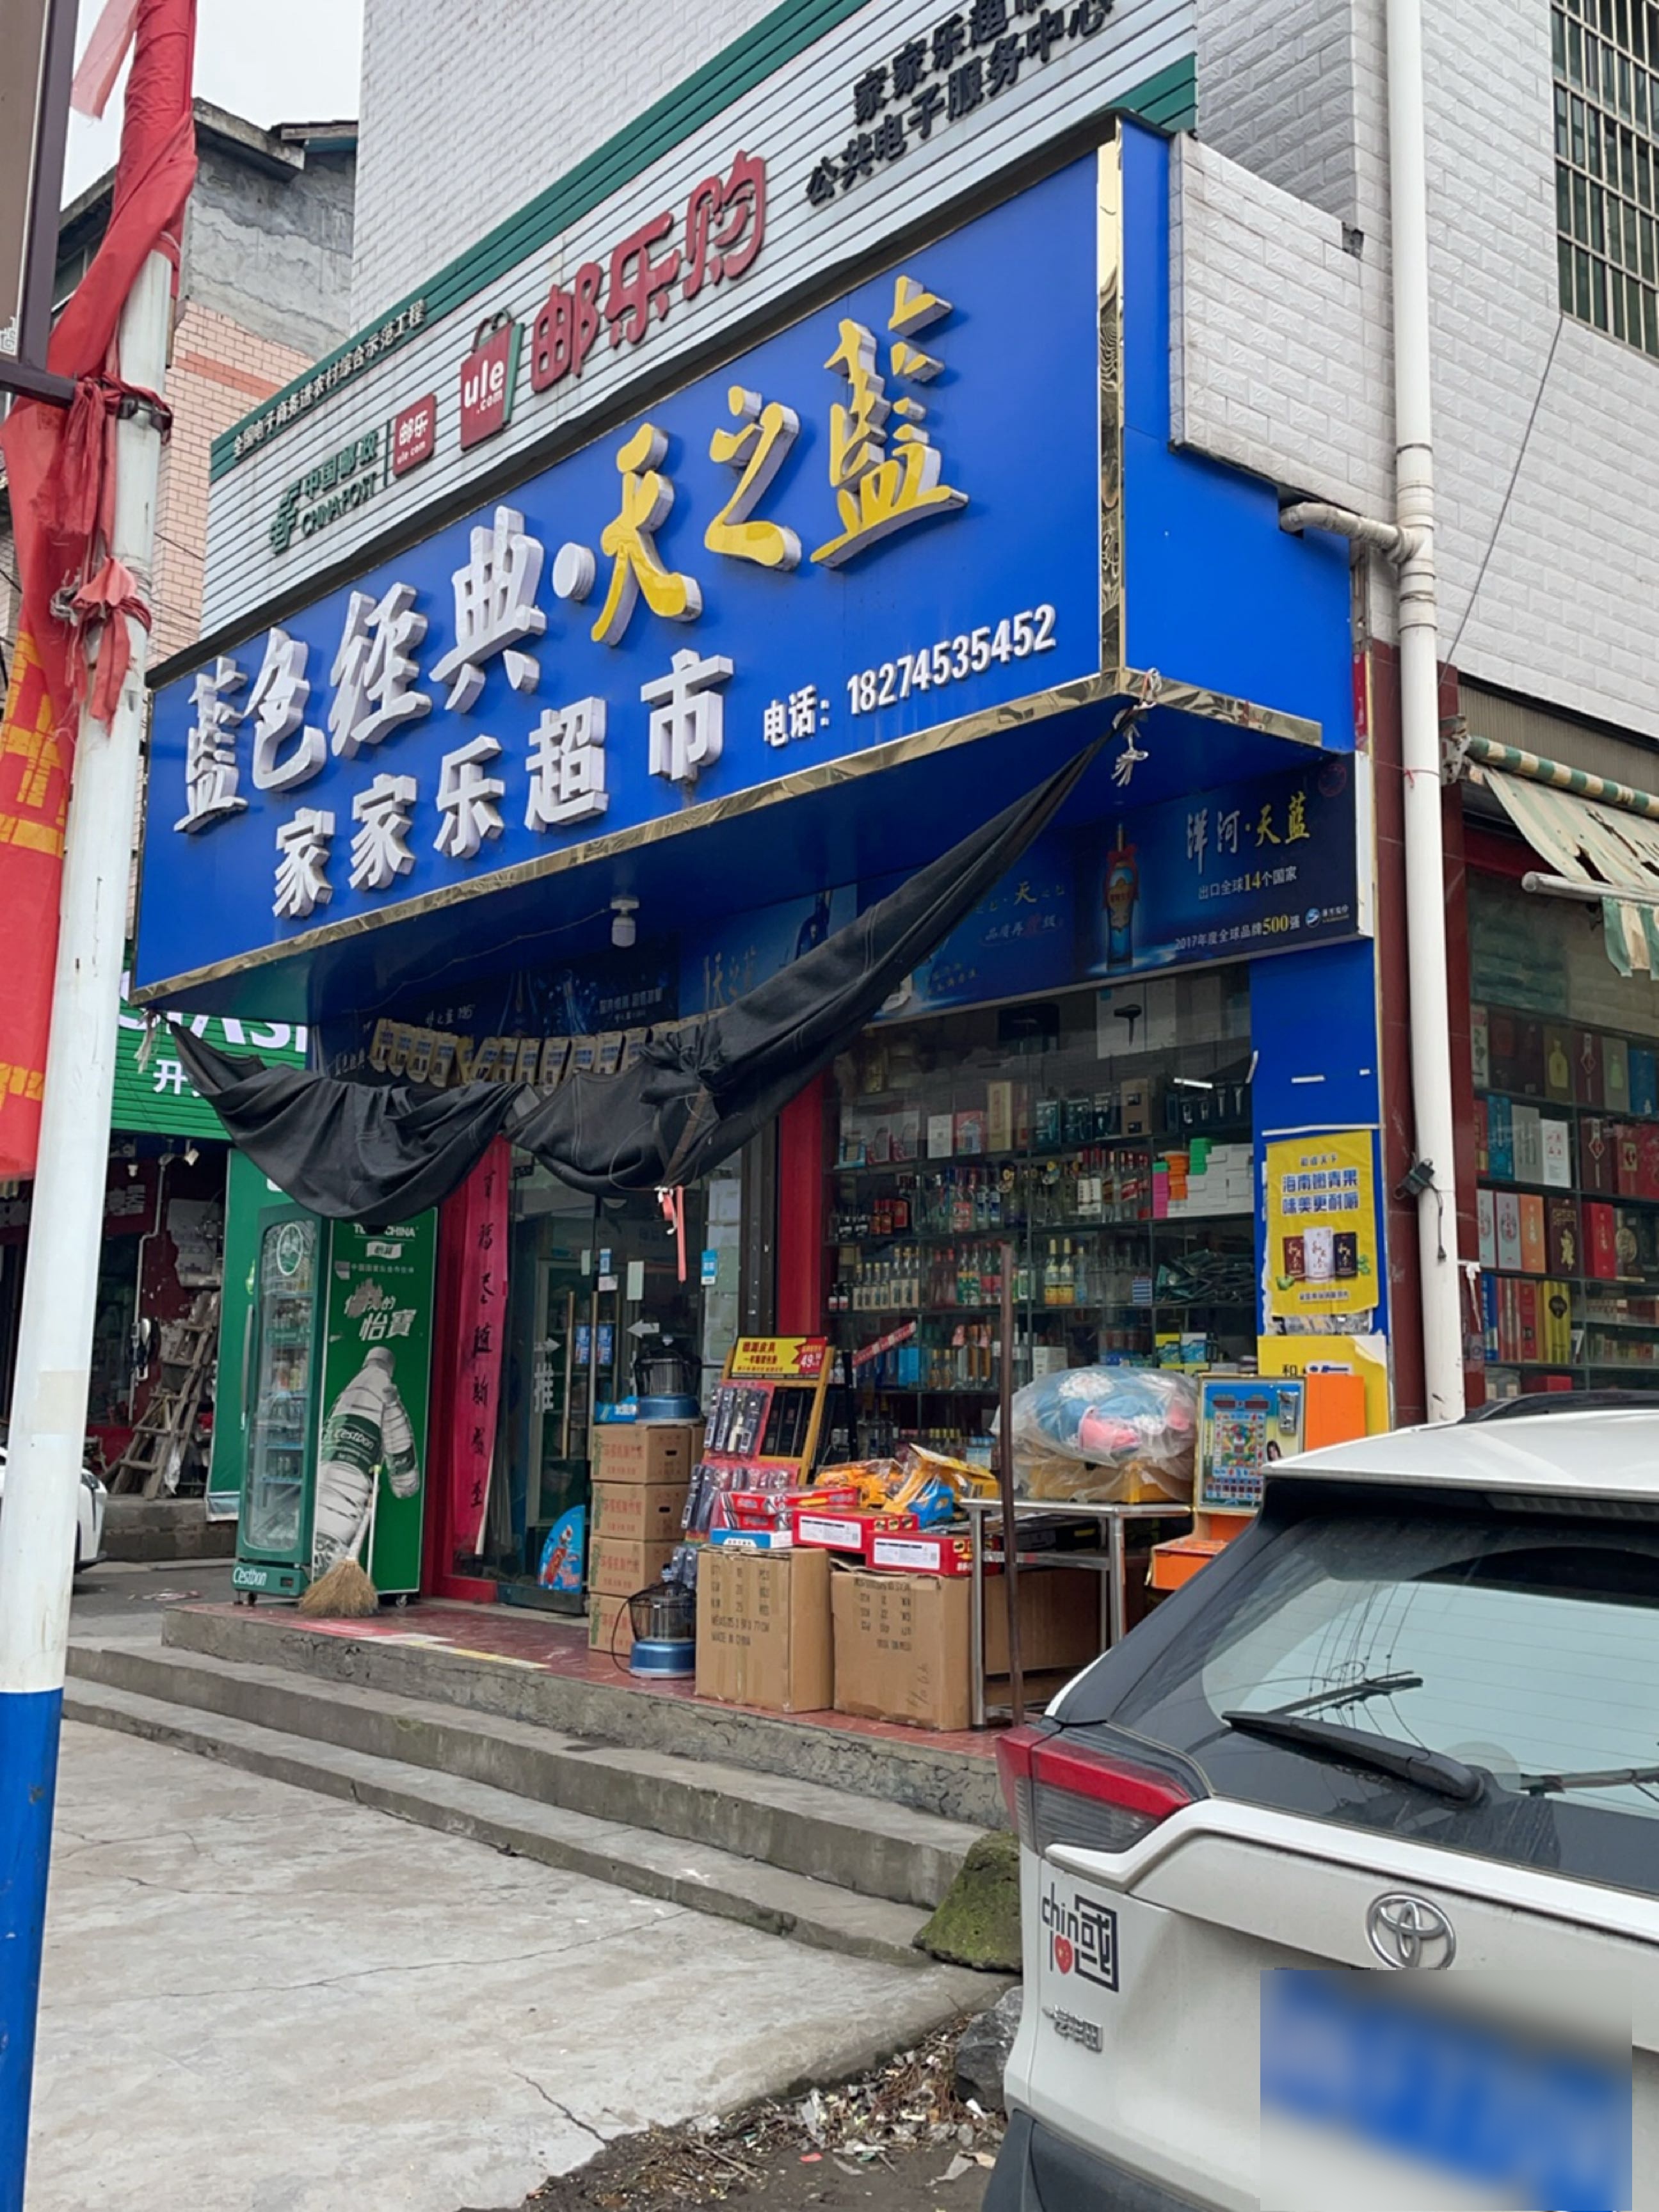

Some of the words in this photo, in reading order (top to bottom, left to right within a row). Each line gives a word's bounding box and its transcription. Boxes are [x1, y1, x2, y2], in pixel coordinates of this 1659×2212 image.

[854, 0, 1042, 125] 家家乐超
[806, 0, 1115, 206] 公共电子服务中心
[531, 150, 767, 394] 邮乐购
[464, 360, 504, 408] ule
[476, 389, 504, 415] .com
[399, 410, 429, 446] 邮乐
[303, 429, 380, 500] 中国邮政
[302, 494, 342, 538] CHINA
[341, 471, 378, 515] POST
[847, 603, 1057, 716] 18274535452
[272, 648, 735, 918] 家家乐超市
[1199, 866, 1297, 900] 出口全球14个国家
